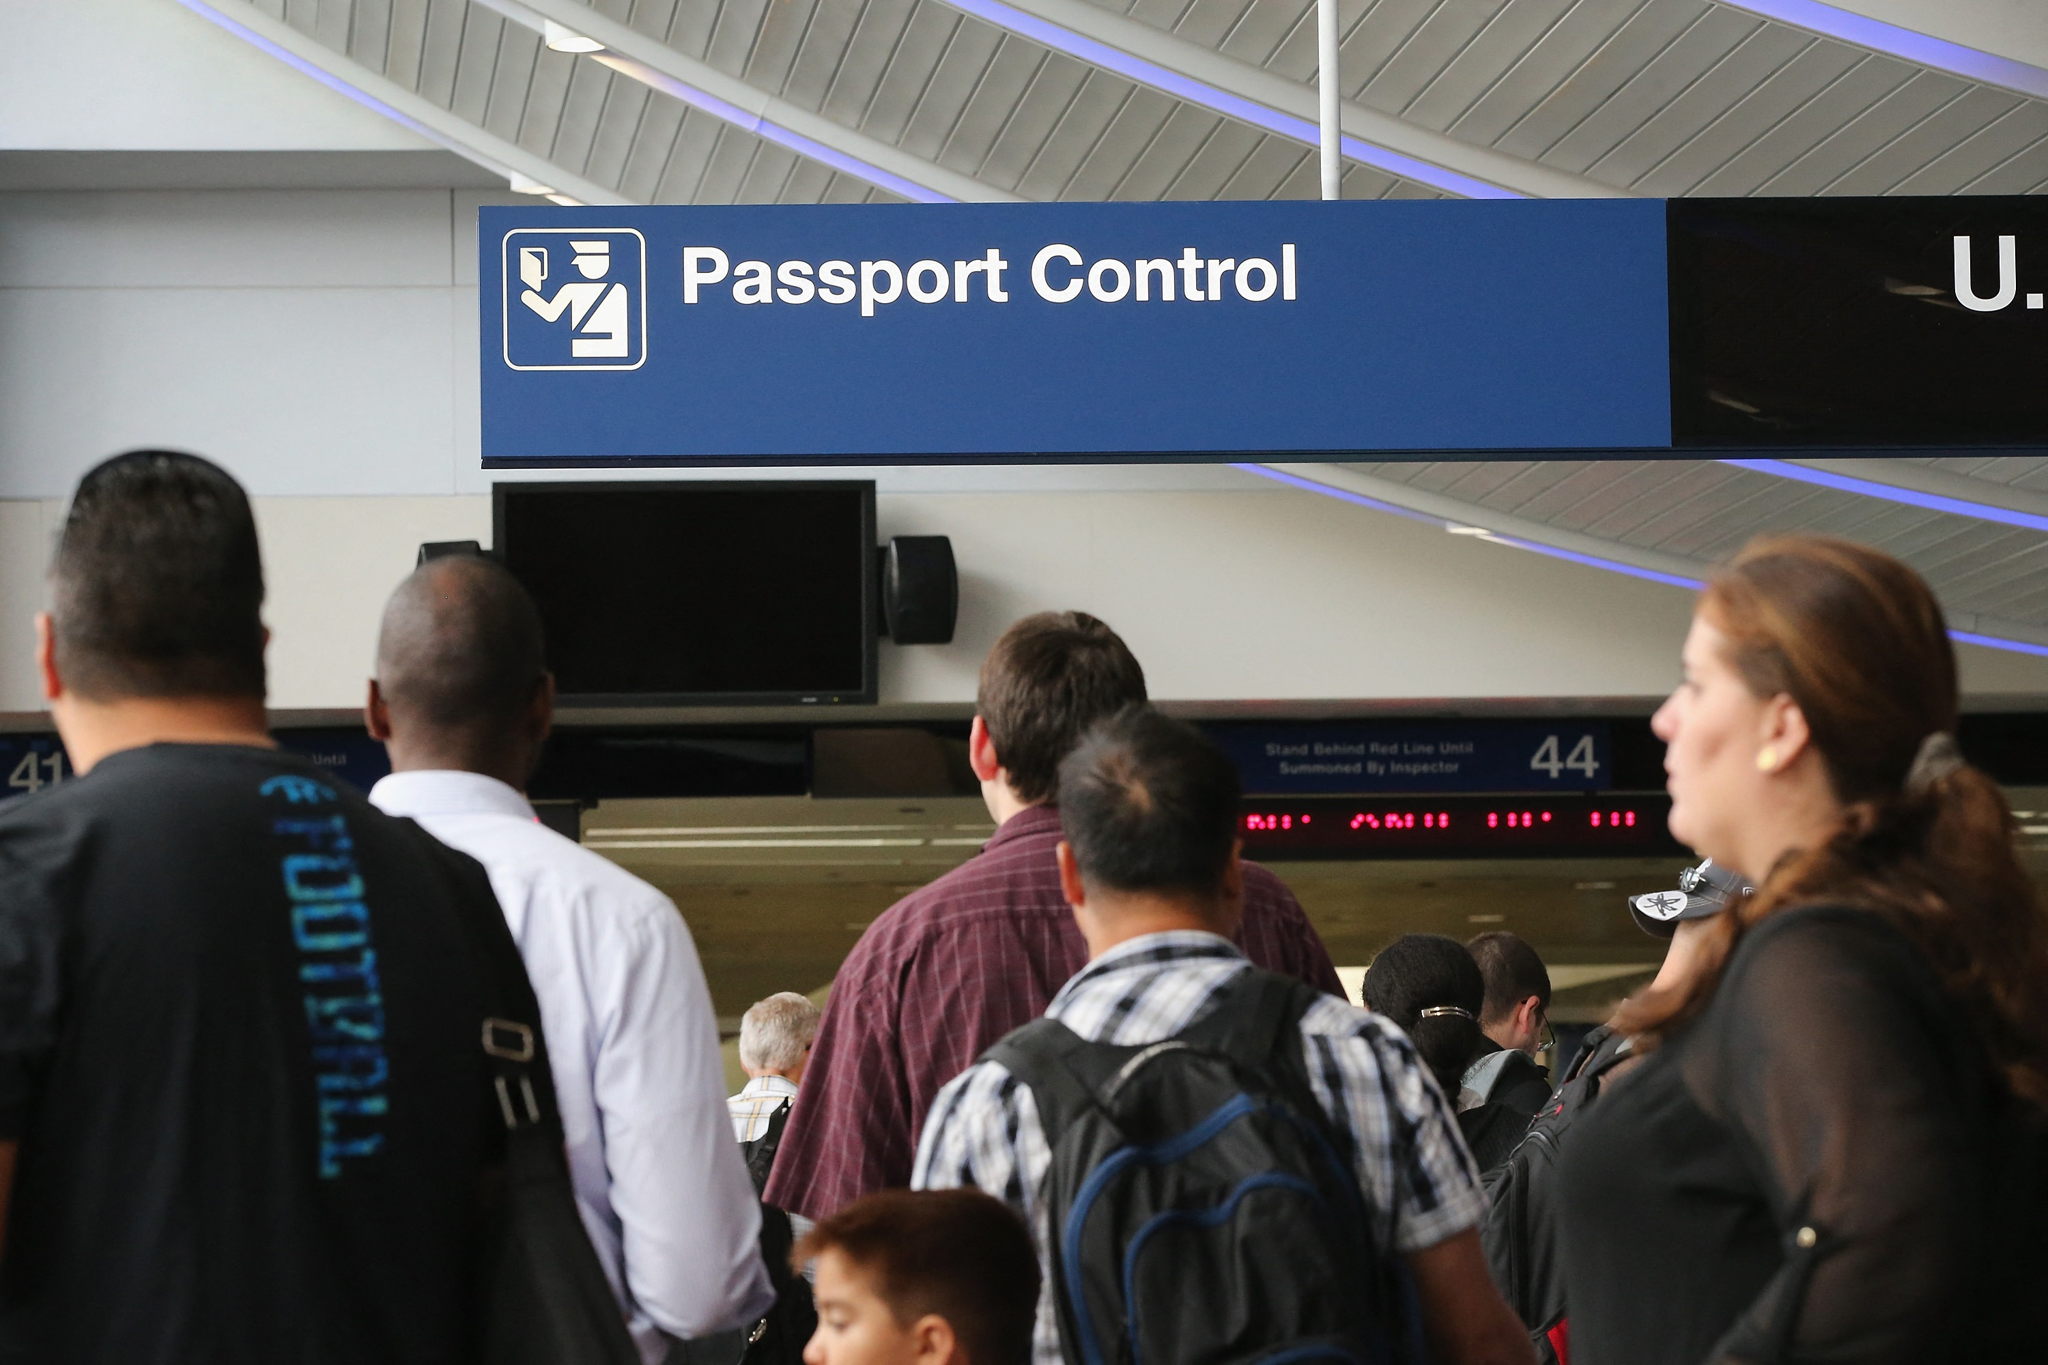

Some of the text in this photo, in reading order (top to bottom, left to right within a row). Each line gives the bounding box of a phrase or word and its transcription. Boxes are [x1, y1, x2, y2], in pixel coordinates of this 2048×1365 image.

[683, 243, 1296, 317] Passport Control
[1953, 235, 2044, 312] U.
[312, 752, 347, 766] Until
[1265, 741, 1473, 756] Stand Behind Red Line Until
[1279, 760, 1459, 776] Summoned By Inspector
[1530, 735, 1599, 778] 44
[8, 750, 63, 794] 41
[273, 814, 391, 1179] FOOTBALL
